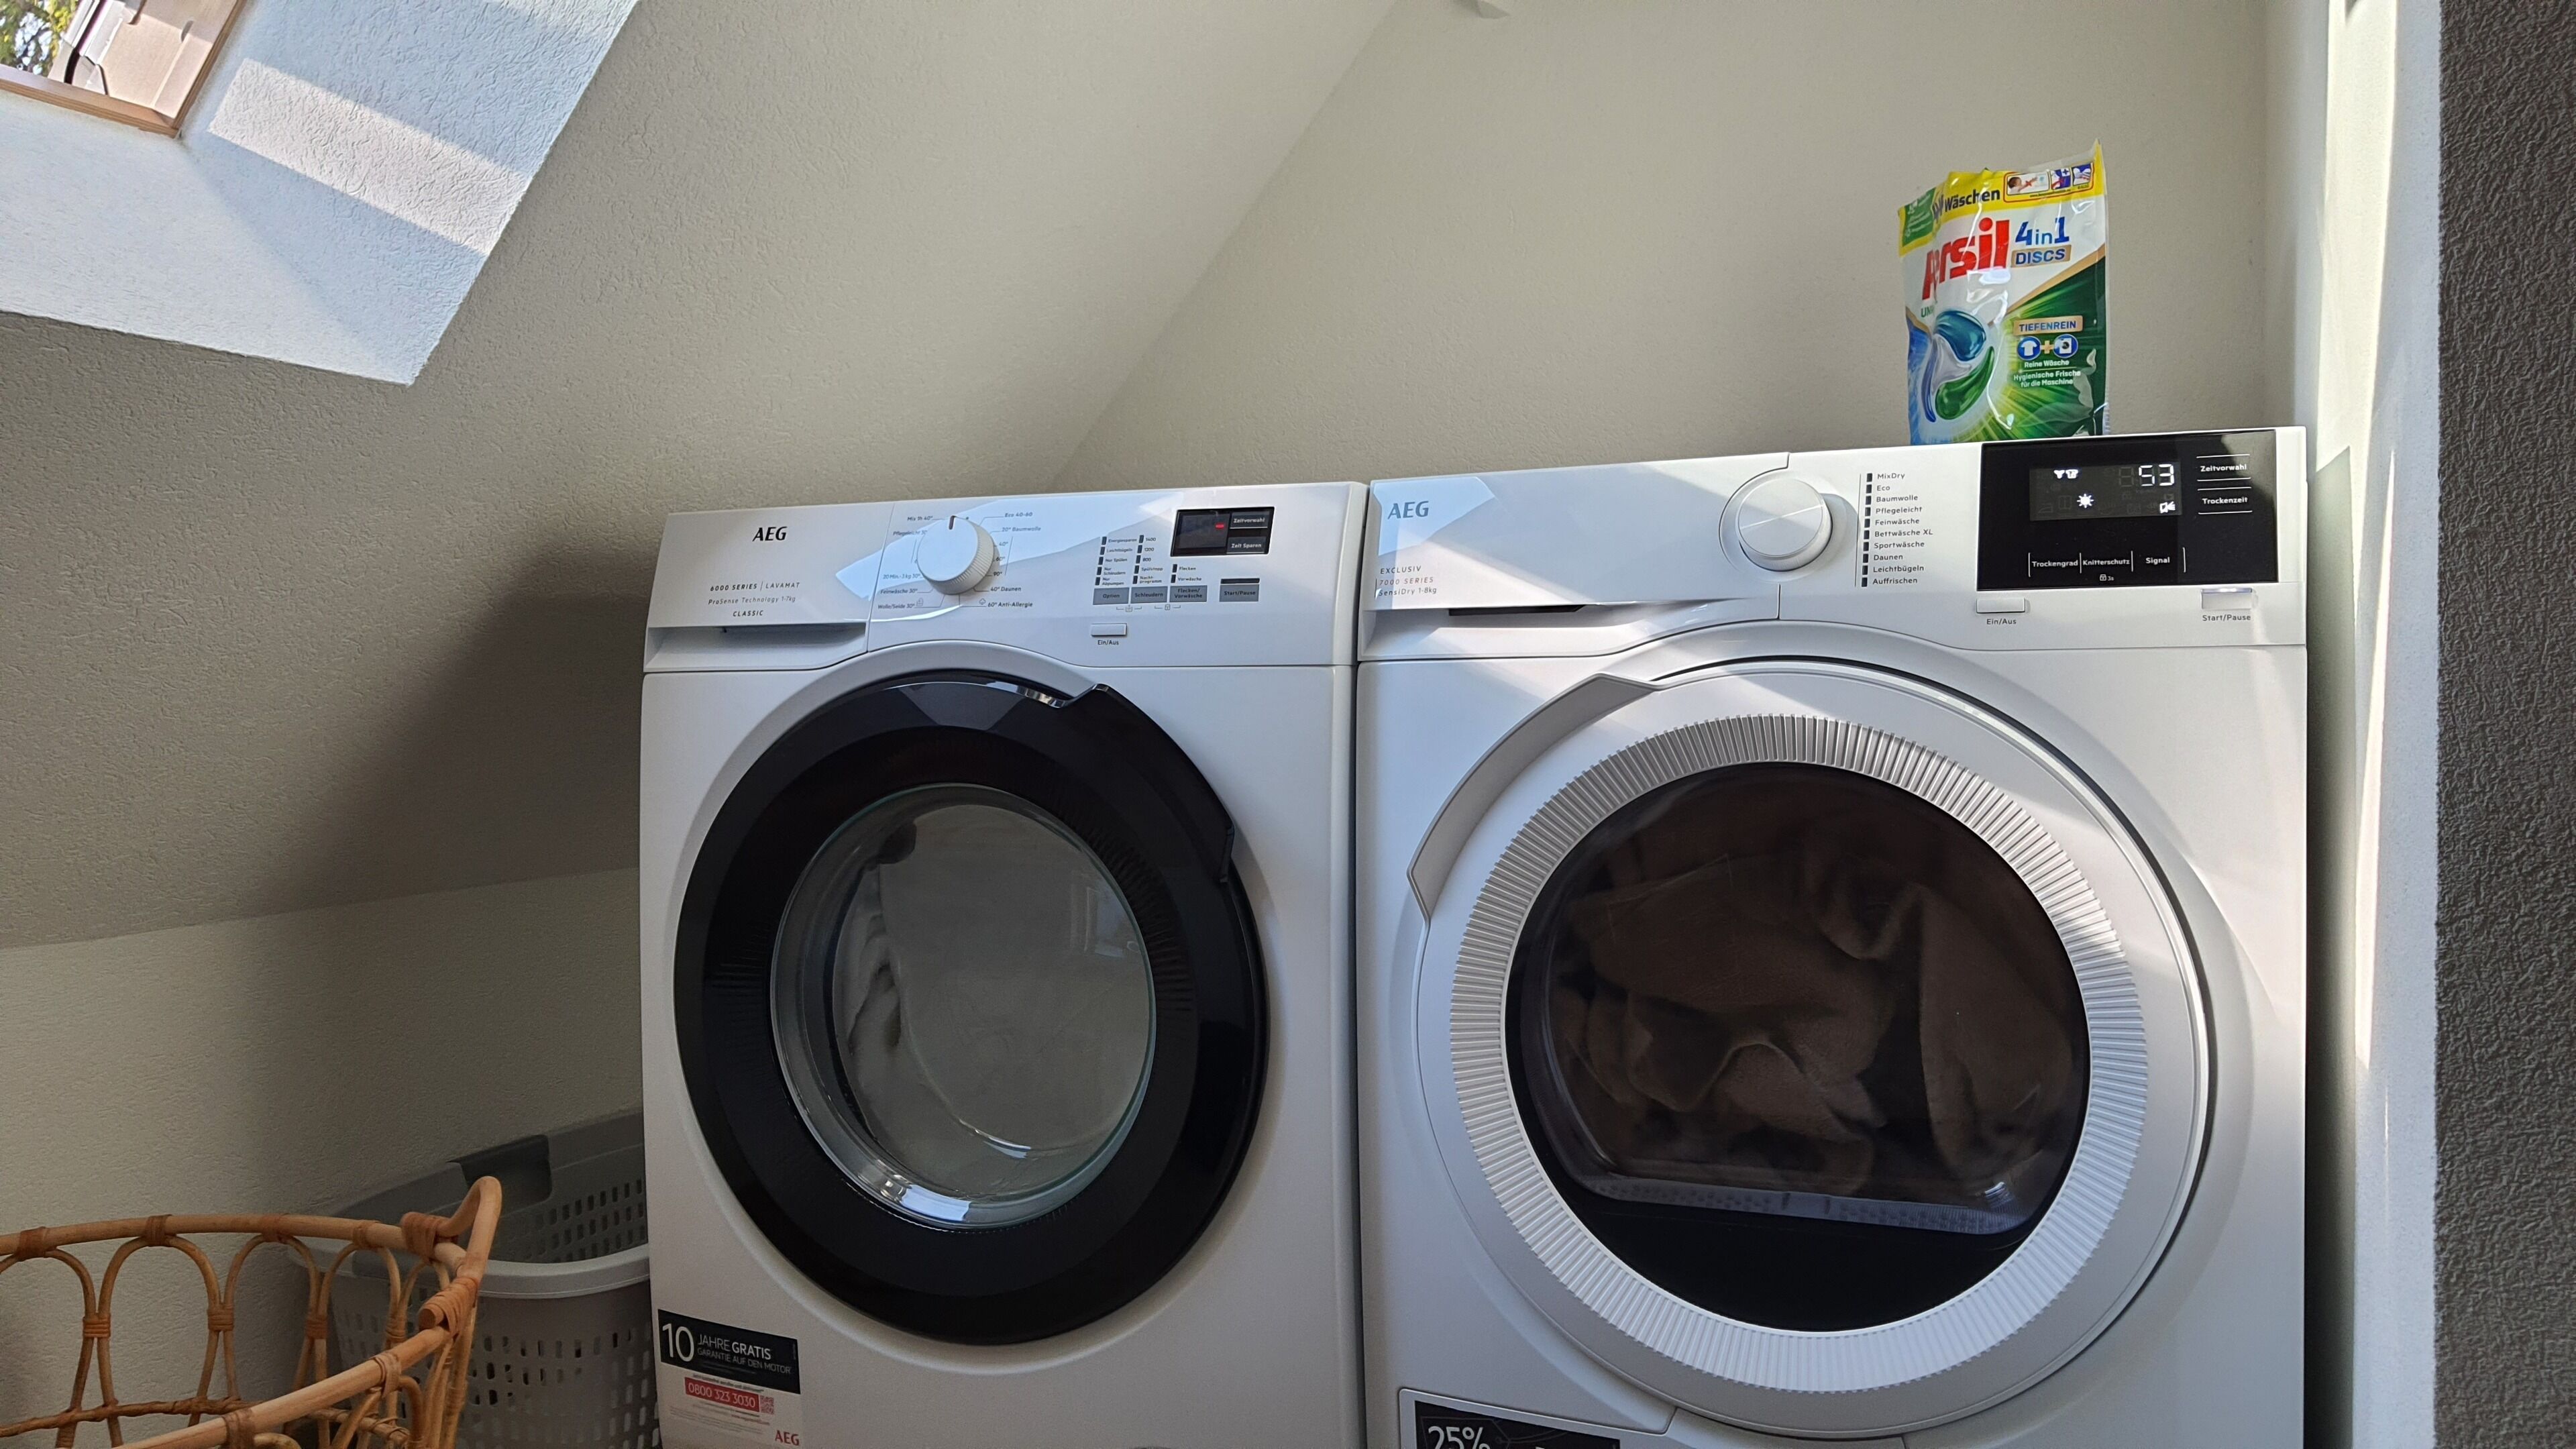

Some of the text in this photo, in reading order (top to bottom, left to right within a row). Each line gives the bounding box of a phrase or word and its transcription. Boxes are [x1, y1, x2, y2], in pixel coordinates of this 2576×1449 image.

[1945, 189, 2000, 212] Wäschen
[2015, 216, 2070, 246] 4in1
[2016, 248, 2065, 264] DISCS
[2019, 321, 2076, 331] TIEFENREIN
[2014, 372, 2054, 381] Hygienische
[2200, 464, 2247, 472] Zeitvorwahl
[2139, 464, 2175, 486] 53
[2202, 496, 2248, 504] Trockenzeit
[1387, 500, 1429, 519] AEG
[1876, 506, 1922, 515] Pflegeleicht
[1875, 518, 1920, 526] Feinwäsche
[752, 526, 788, 542] AEG
[1874, 541, 1925, 549] Sportwäsche
[2032, 559, 2078, 568] Trockengrad
[2145, 557, 2170, 566] Signal
[1380, 566, 1421, 574] EXCLUSIV
[1873, 565, 1924, 574] Leichtbügeln
[1379, 588, 1415, 596] SensiDry
[662, 1323, 695, 1362] 10
[698, 1334, 731, 1352] JAHRE
[731, 1342, 772, 1360] GRATIS
[697, 1348, 731, 1362] GARANTIE
[732, 1356, 747, 1365] AUF
[747, 1358, 763, 1369] DEN
[688, 1382, 712, 1398] 0800
[714, 1389, 731, 1402] 323
[732, 1393, 756, 1407] 3030
[774, 1430, 800, 1446] AEG
[1428, 1426, 1491, 1449] 25%
